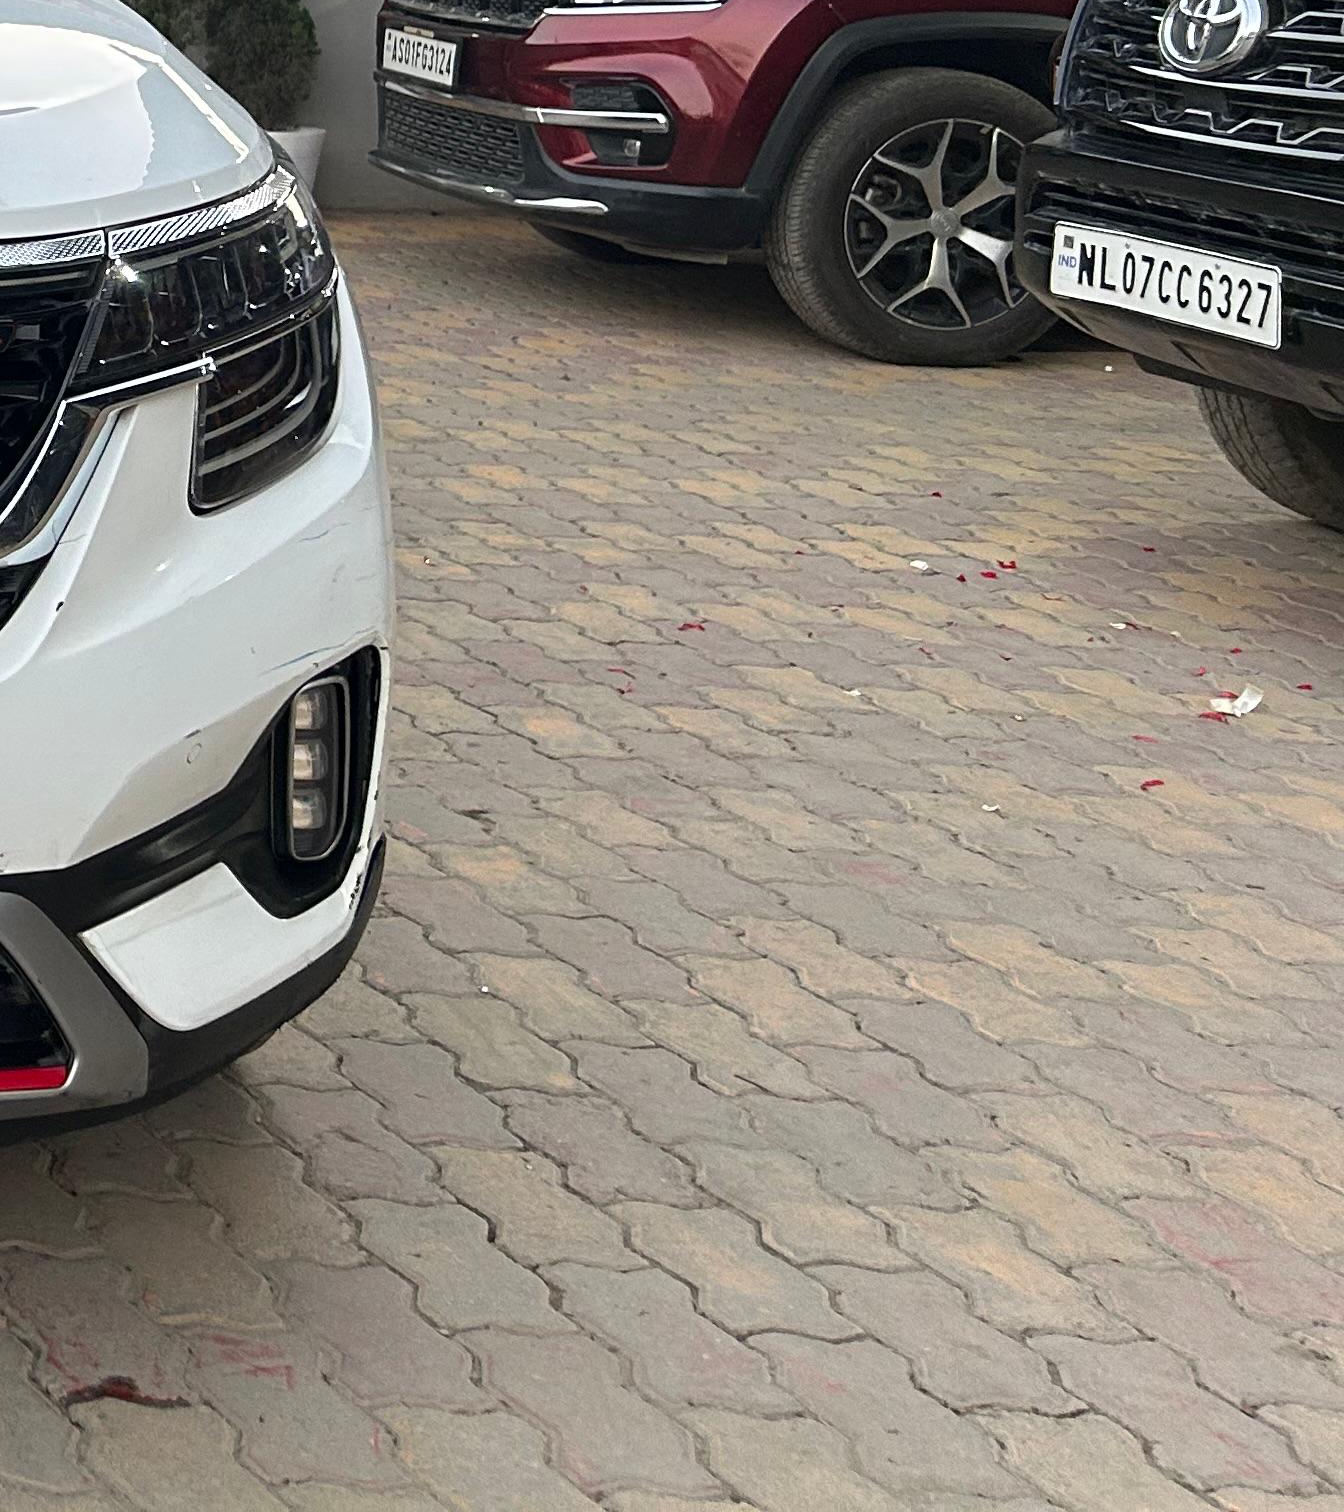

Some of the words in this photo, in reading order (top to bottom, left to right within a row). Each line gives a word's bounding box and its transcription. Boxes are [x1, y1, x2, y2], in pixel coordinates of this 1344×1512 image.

[392, 35, 452, 76] AS01FG3124
[1058, 254, 1077, 268] IND
[1077, 242, 1273, 328] NL07CC6327
